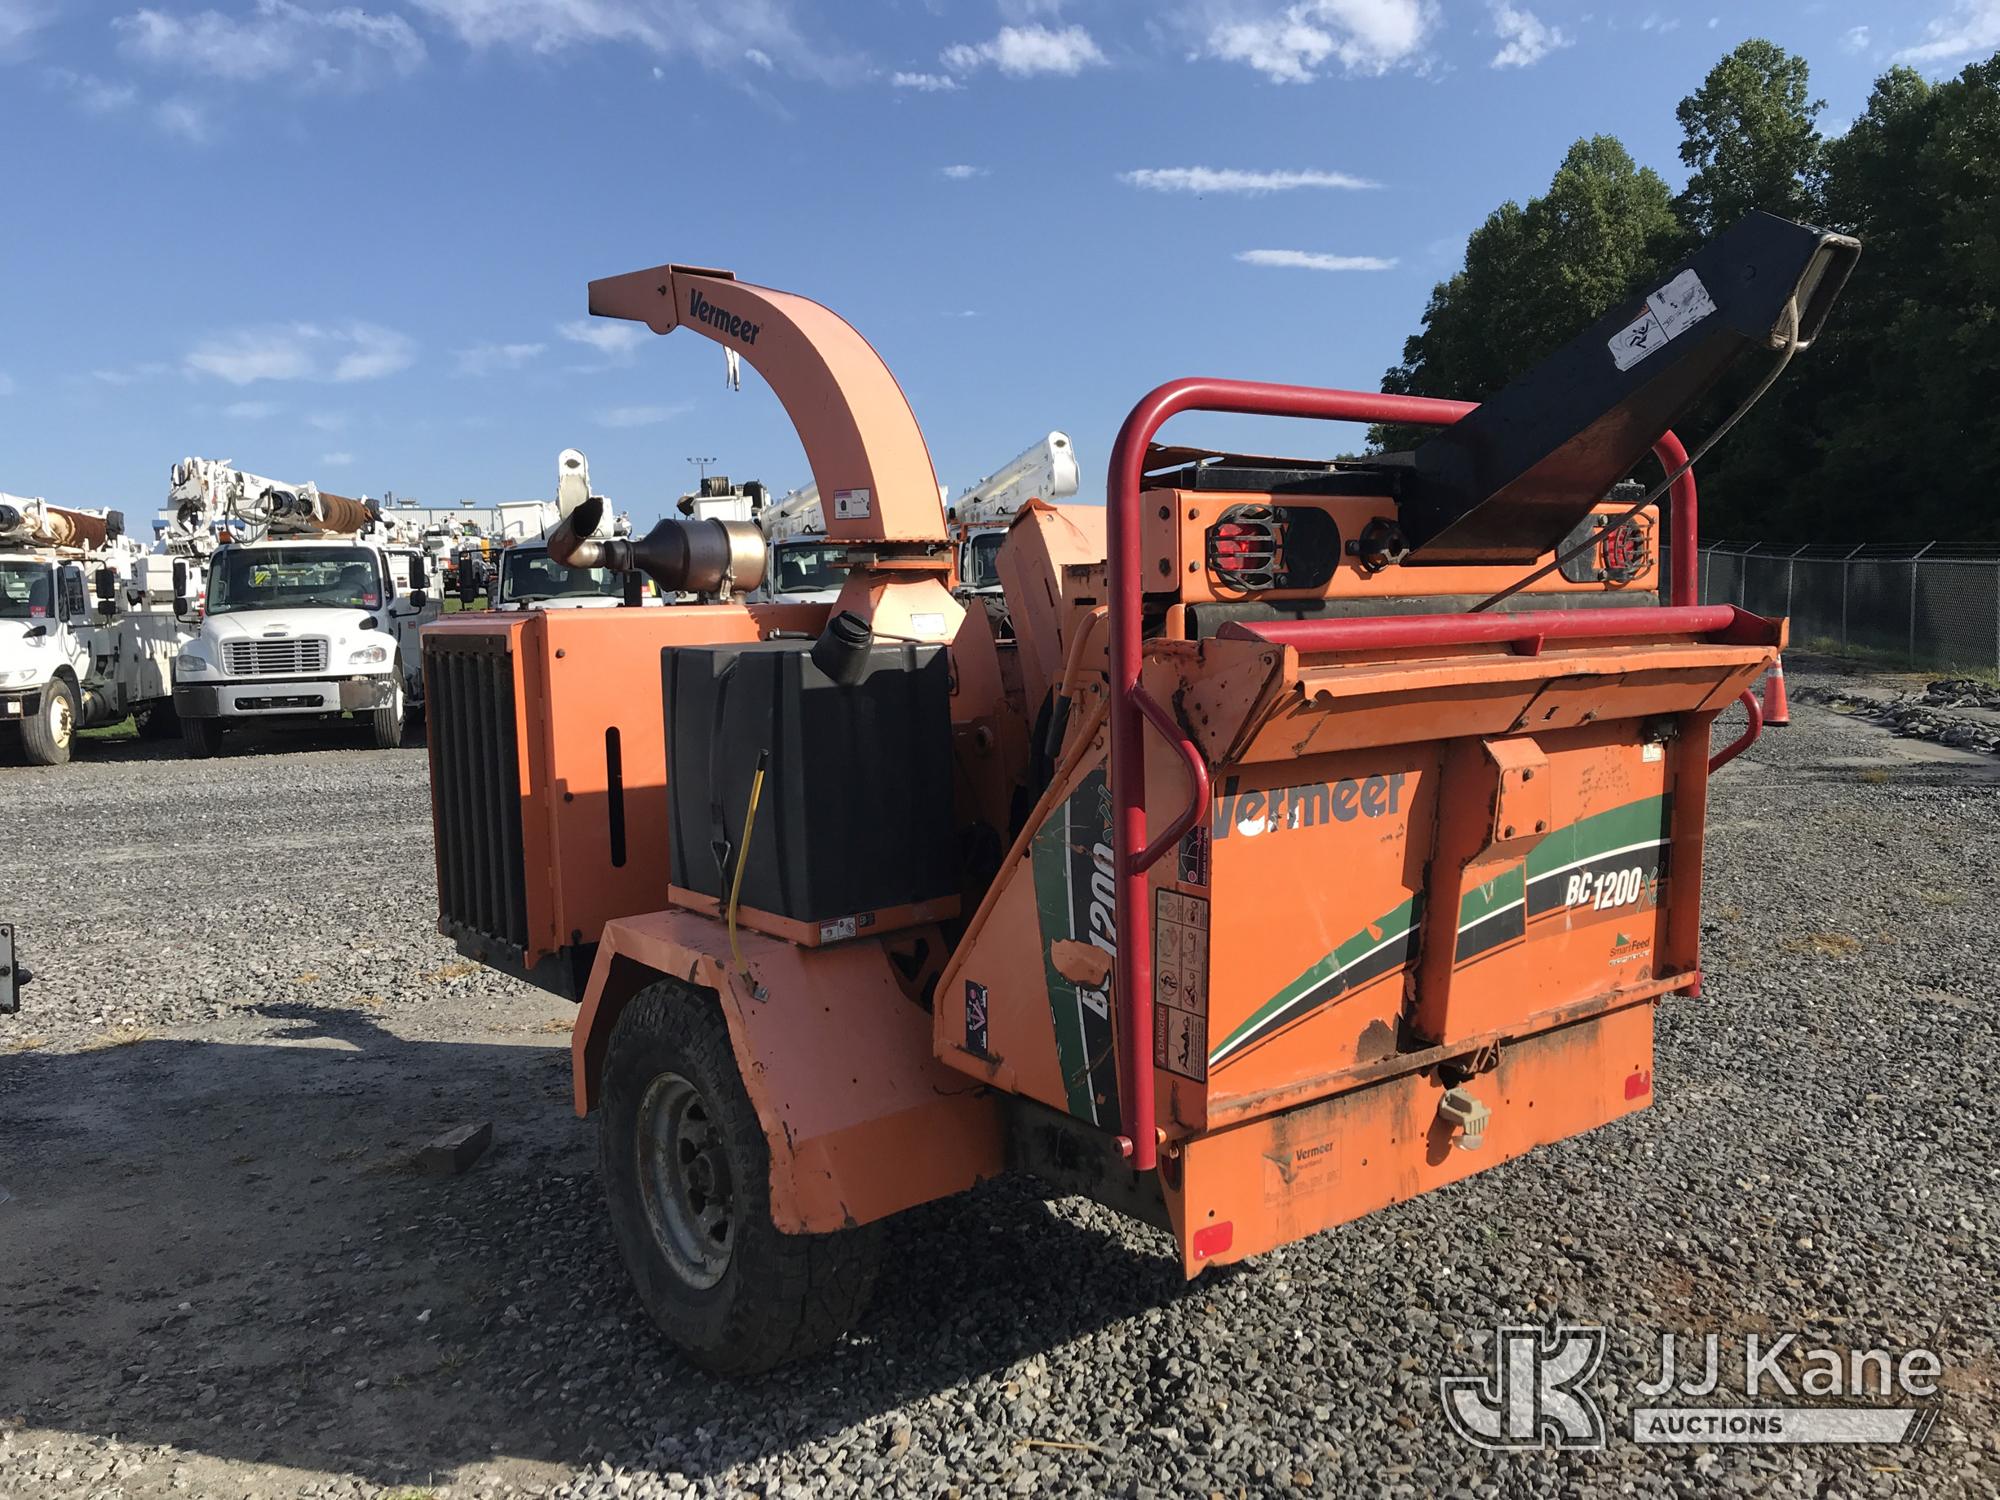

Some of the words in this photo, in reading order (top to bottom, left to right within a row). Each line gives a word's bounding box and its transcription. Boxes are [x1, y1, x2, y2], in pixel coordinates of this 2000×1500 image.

[690, 288, 760, 345] Vermeer
[1213, 774, 1405, 840] Vermeer
[1089, 842, 1117, 958] 1200
[1565, 872, 1593, 906] BC
[1593, 866, 1643, 911] 1200
[1158, 1006, 1166, 1051] DANGER
[1296, 1142, 1334, 1161] Vermeer
